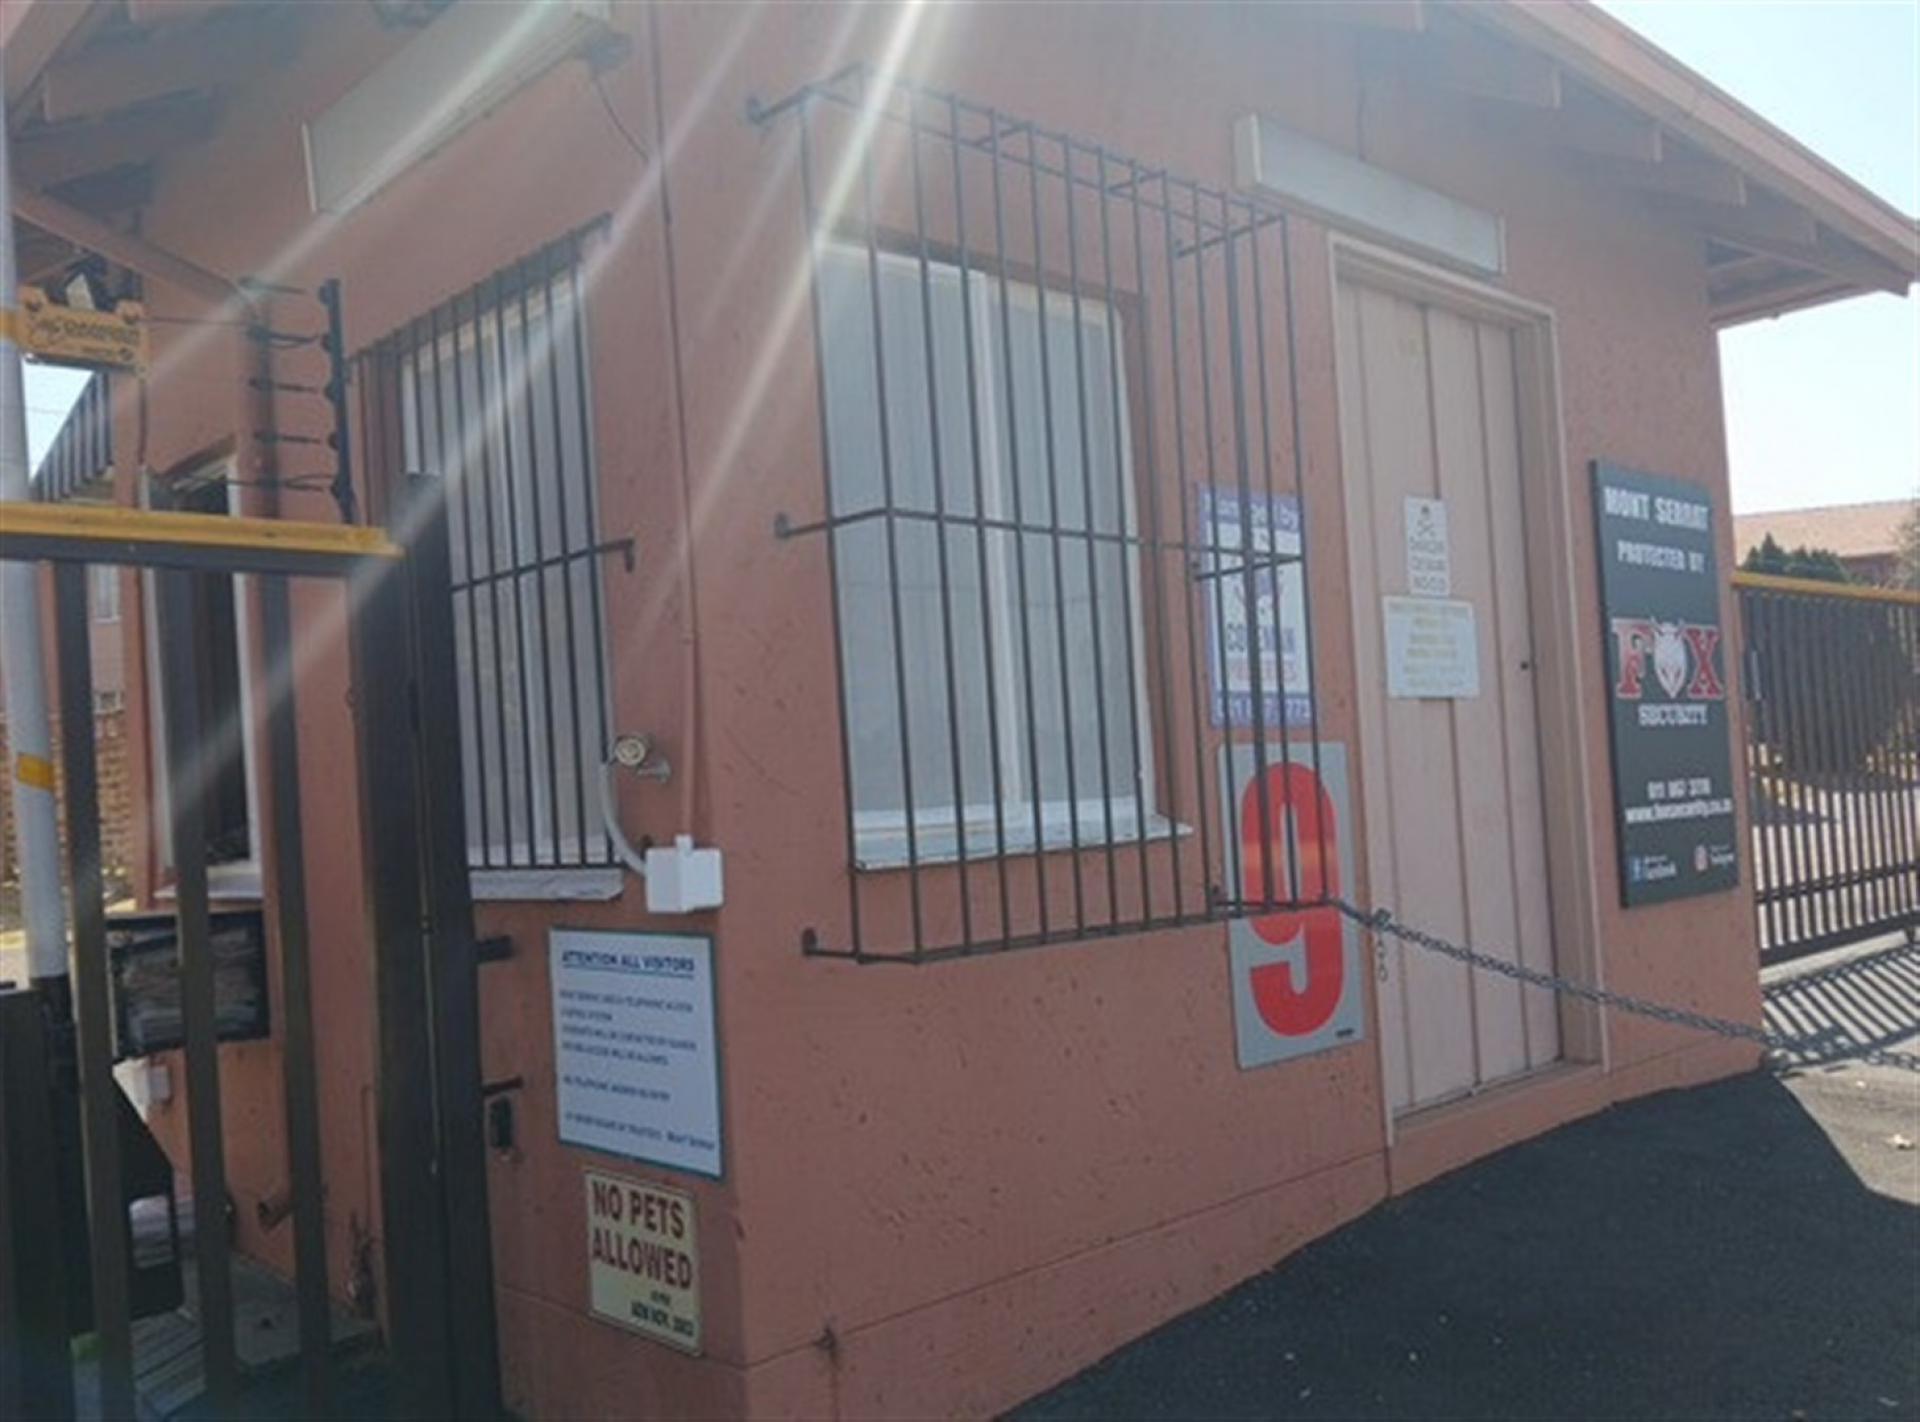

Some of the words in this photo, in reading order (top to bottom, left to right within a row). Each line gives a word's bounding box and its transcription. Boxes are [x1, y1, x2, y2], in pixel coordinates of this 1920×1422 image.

[1604, 486, 1649, 520] MONT
[1654, 496, 1709, 530] SERRAT
[1617, 540, 1685, 571] PROTECTED
[1688, 551, 1705, 574] BY
[1638, 703, 1708, 726] SECURITY
[1241, 760, 1343, 1037] 9
[562, 950, 618, 965] ATTENTION
[620, 953, 642, 969] ALL
[642, 954, 695, 972] VISITORS
[592, 1179, 622, 1222] NO
[629, 1189, 685, 1240] PETS
[593, 1226, 692, 1290] ALLOWED
